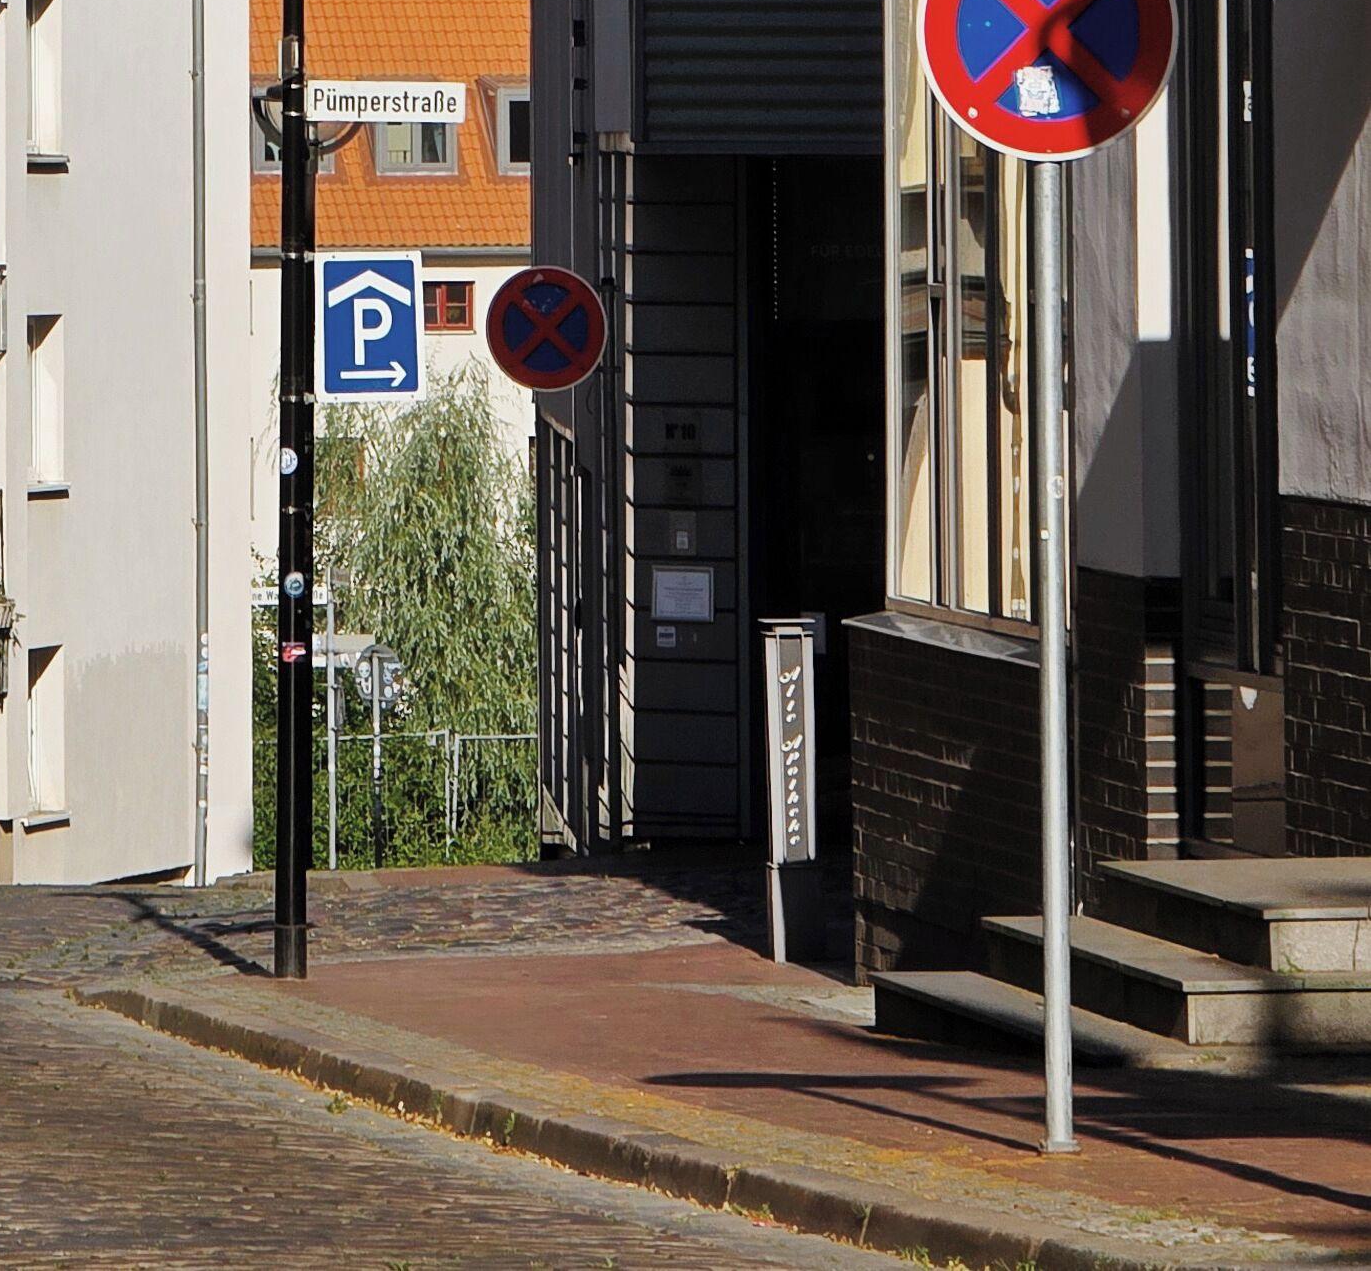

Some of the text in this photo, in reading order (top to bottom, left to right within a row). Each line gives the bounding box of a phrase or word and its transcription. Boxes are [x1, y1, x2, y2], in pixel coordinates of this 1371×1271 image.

[313, 88, 457, 118] Pümperstraße
[353, 298, 393, 366] P
[681, 423, 696, 441] 10
[781, 734, 803, 846] Apotheke
